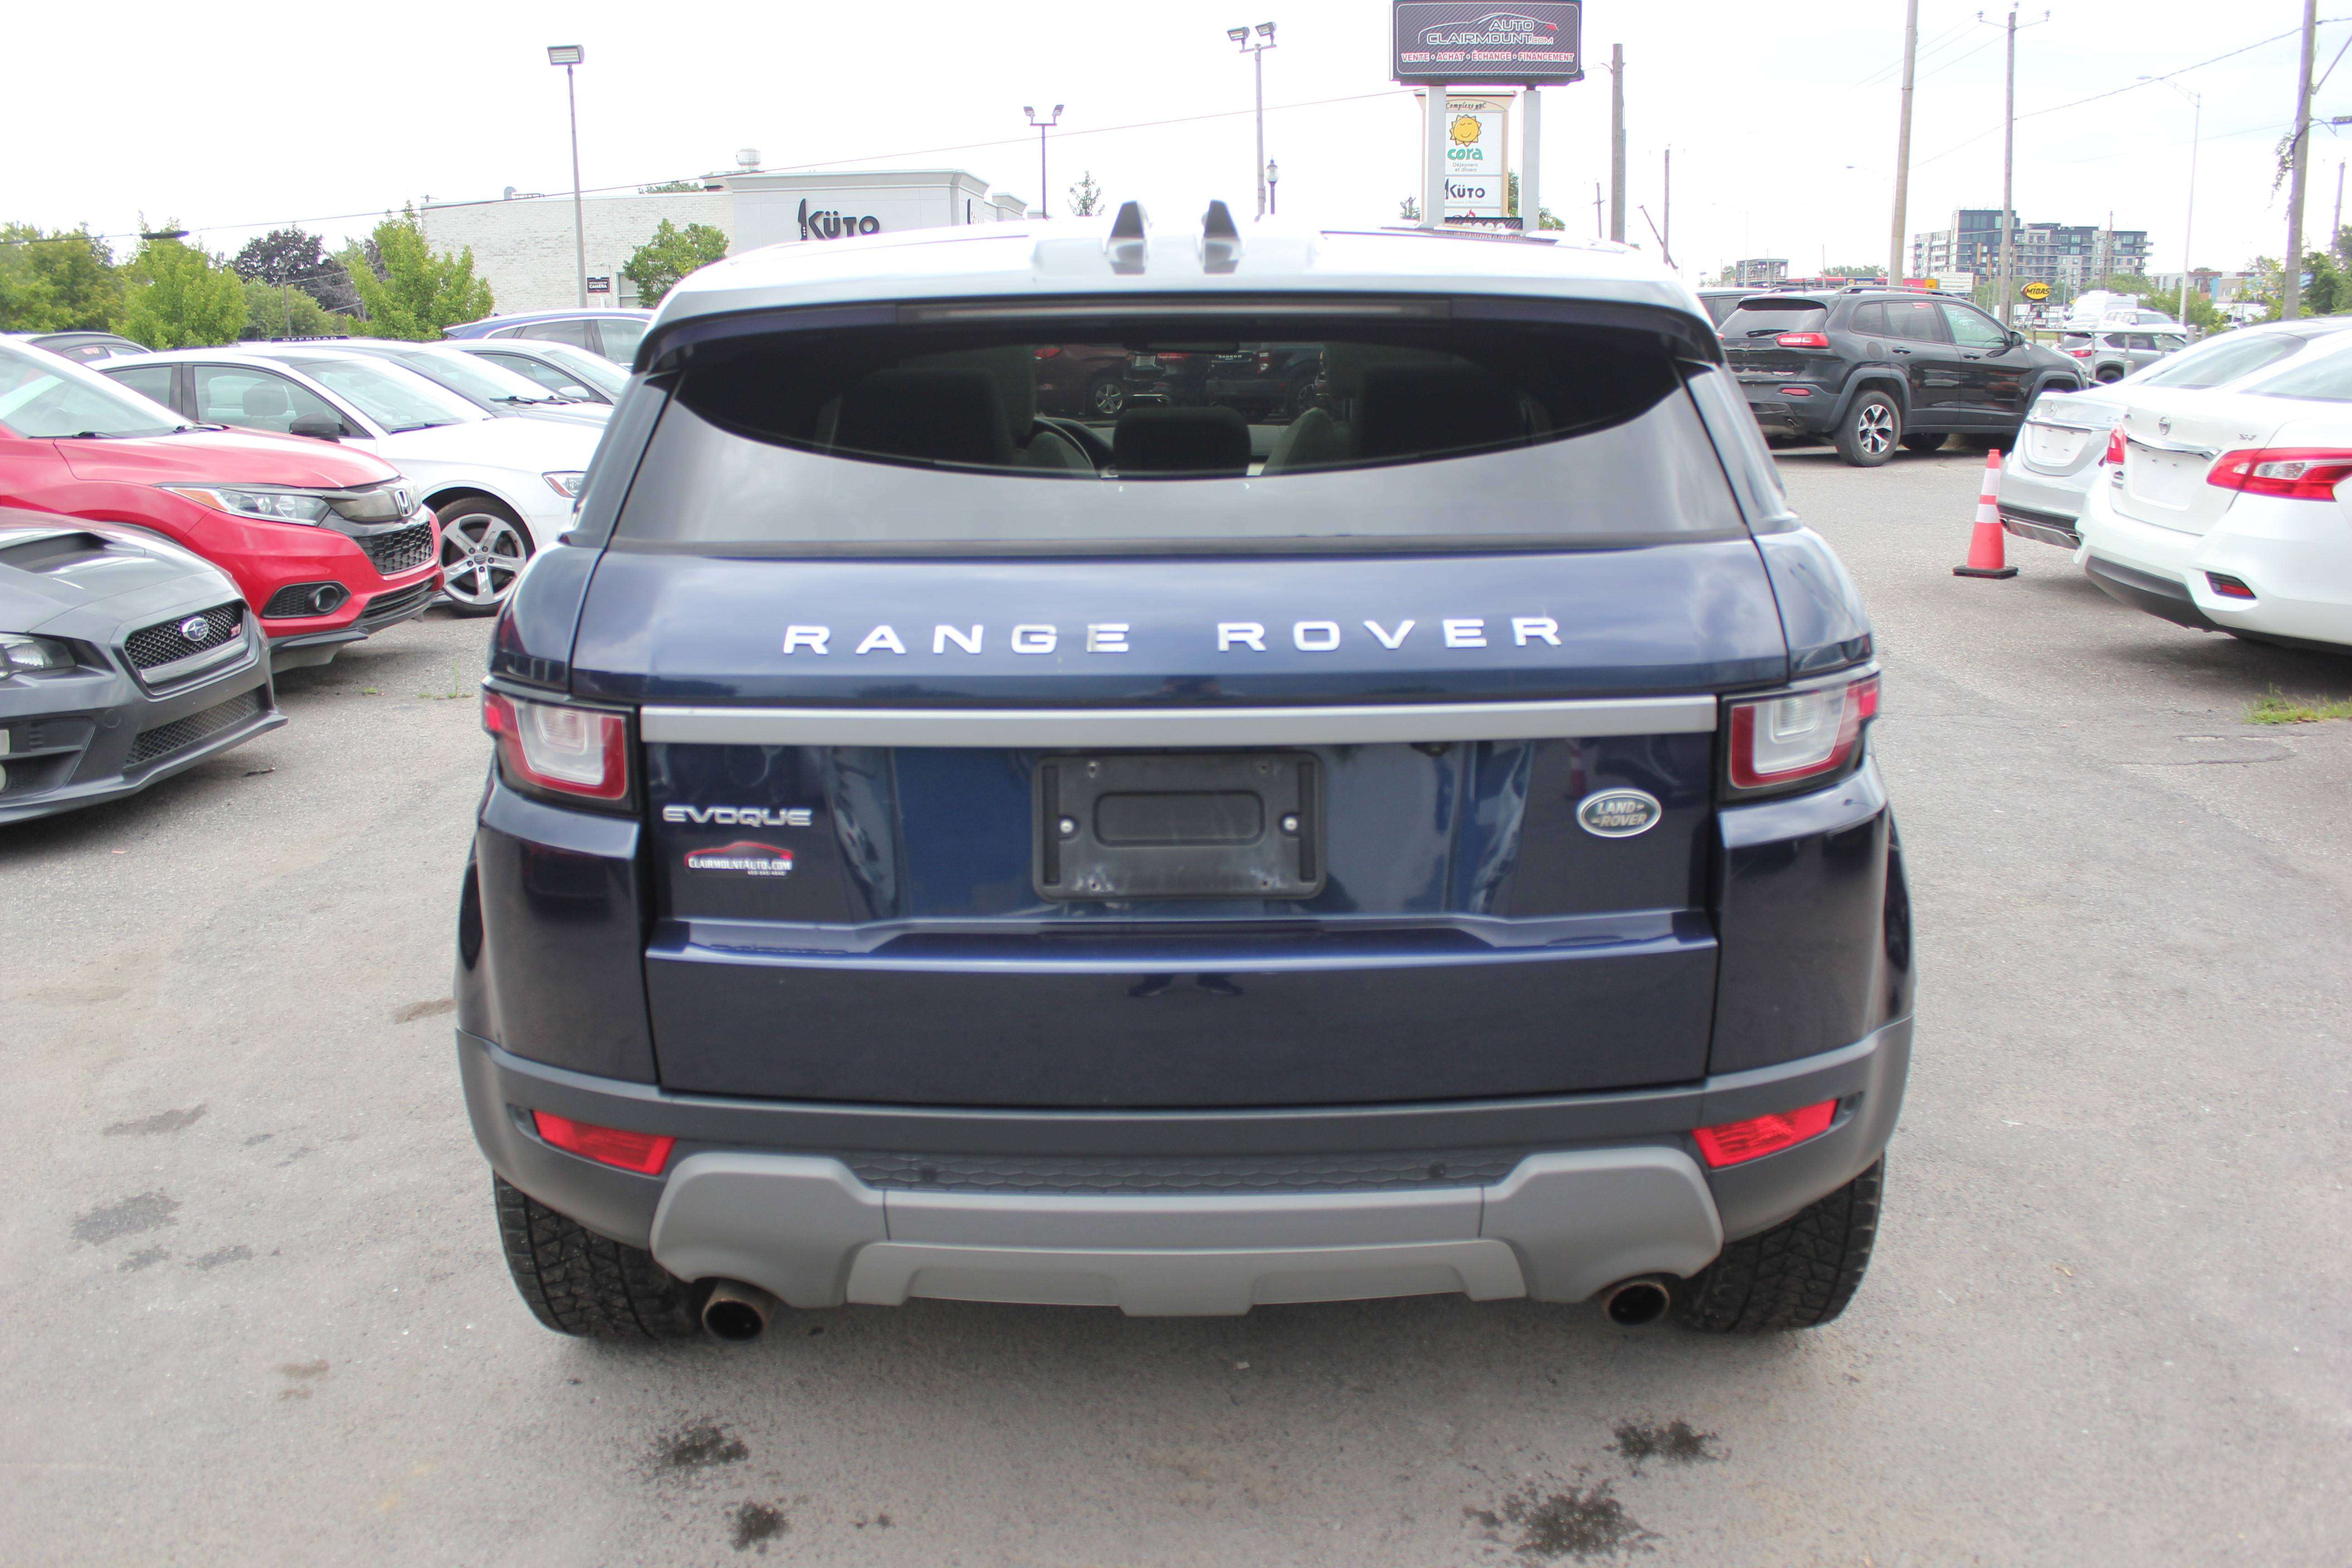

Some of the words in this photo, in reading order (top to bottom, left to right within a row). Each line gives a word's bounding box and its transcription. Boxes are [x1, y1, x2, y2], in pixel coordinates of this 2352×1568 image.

[1489, 20, 1534, 31] AUTO
[1401, 53, 1430, 62] VENTE
[1436, 52, 1465, 62] ACHAT
[1471, 50, 1511, 61] ÉCHANGE
[1518, 53, 1574, 62] FINANCEMENT
[1446, 101, 1474, 110] Complexe
[1447, 148, 1483, 160] cora
[1445, 178, 1485, 199] KÜTO
[798, 198, 880, 240] KÜTO
[783, 623, 1130, 655] RANGE
[1217, 617, 1562, 652] ROVER
[662, 804, 813, 828] EVOQUE
[1599, 813, 1648, 827] ROVER
